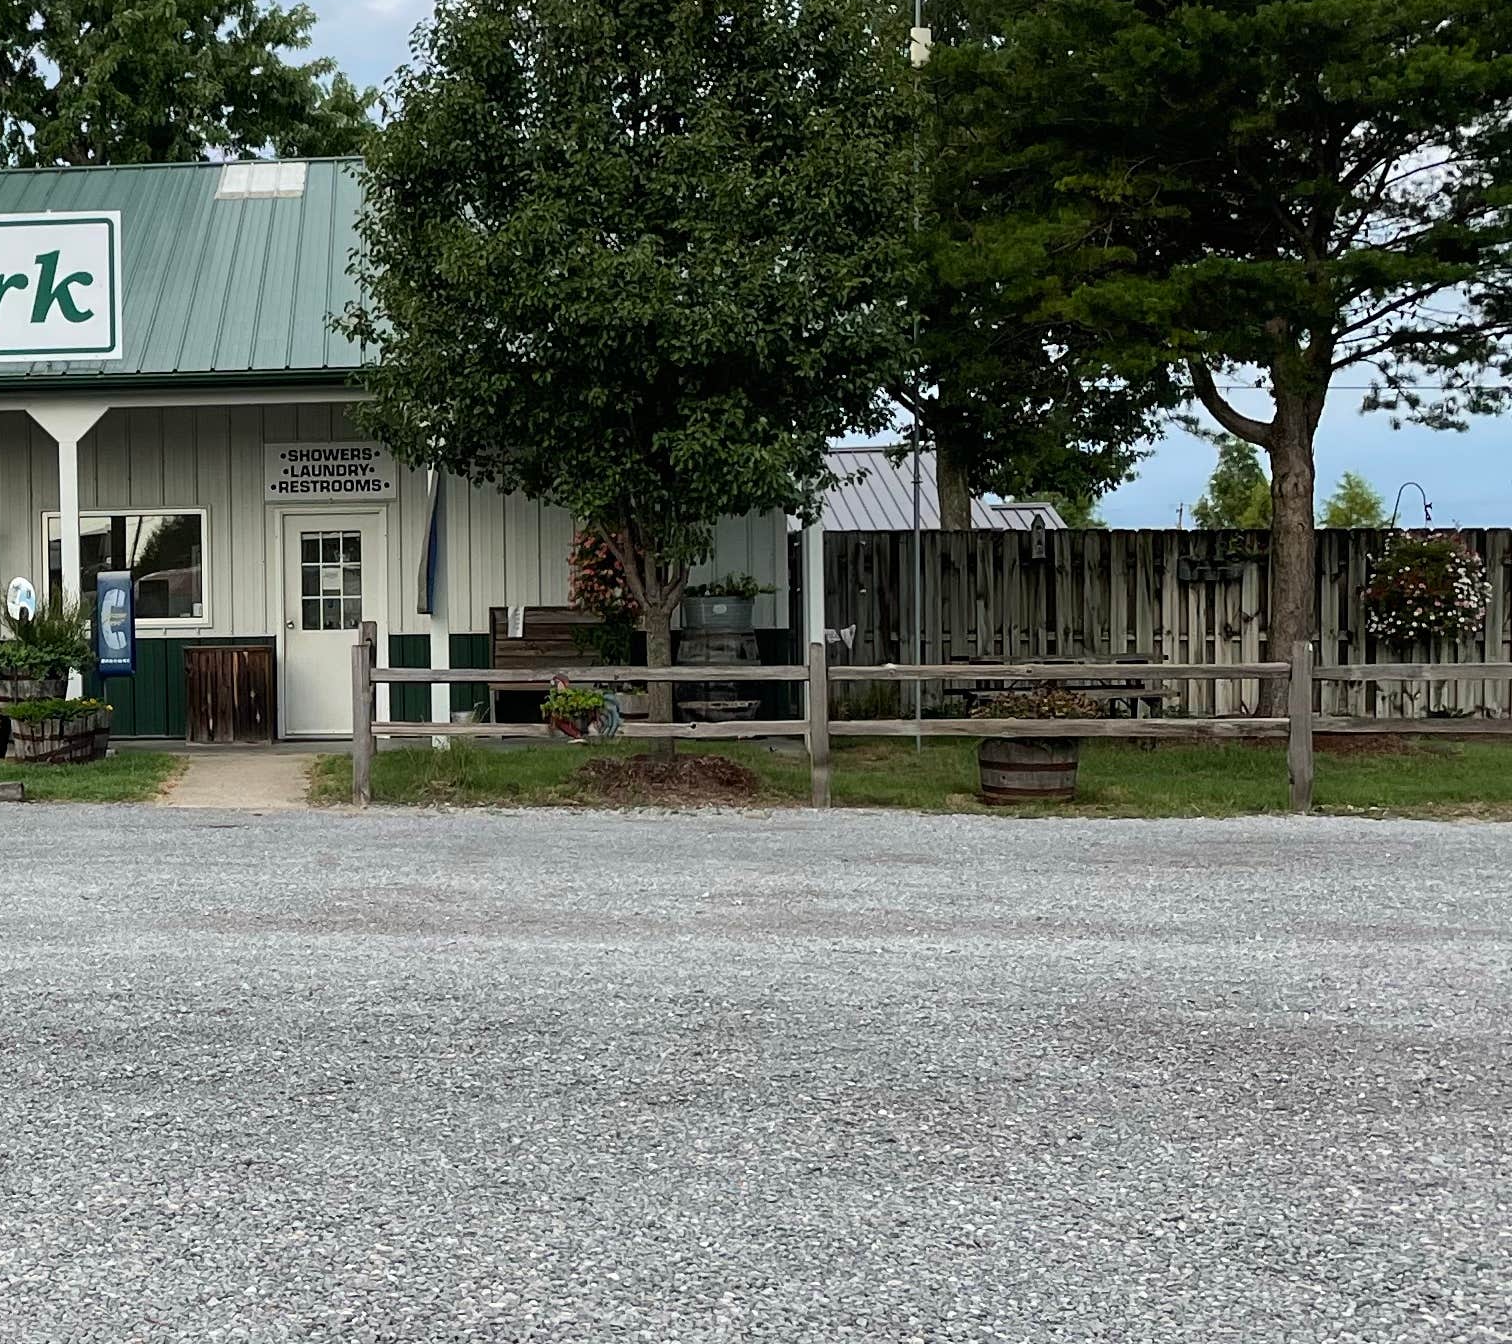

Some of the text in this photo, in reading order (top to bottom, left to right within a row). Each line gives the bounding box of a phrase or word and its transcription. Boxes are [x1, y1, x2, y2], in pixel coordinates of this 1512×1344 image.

[288, 447, 372, 462] SHOWERS
[290, 463, 370, 478] LAUNDRY
[278, 479, 382, 494] RESTROOMS
